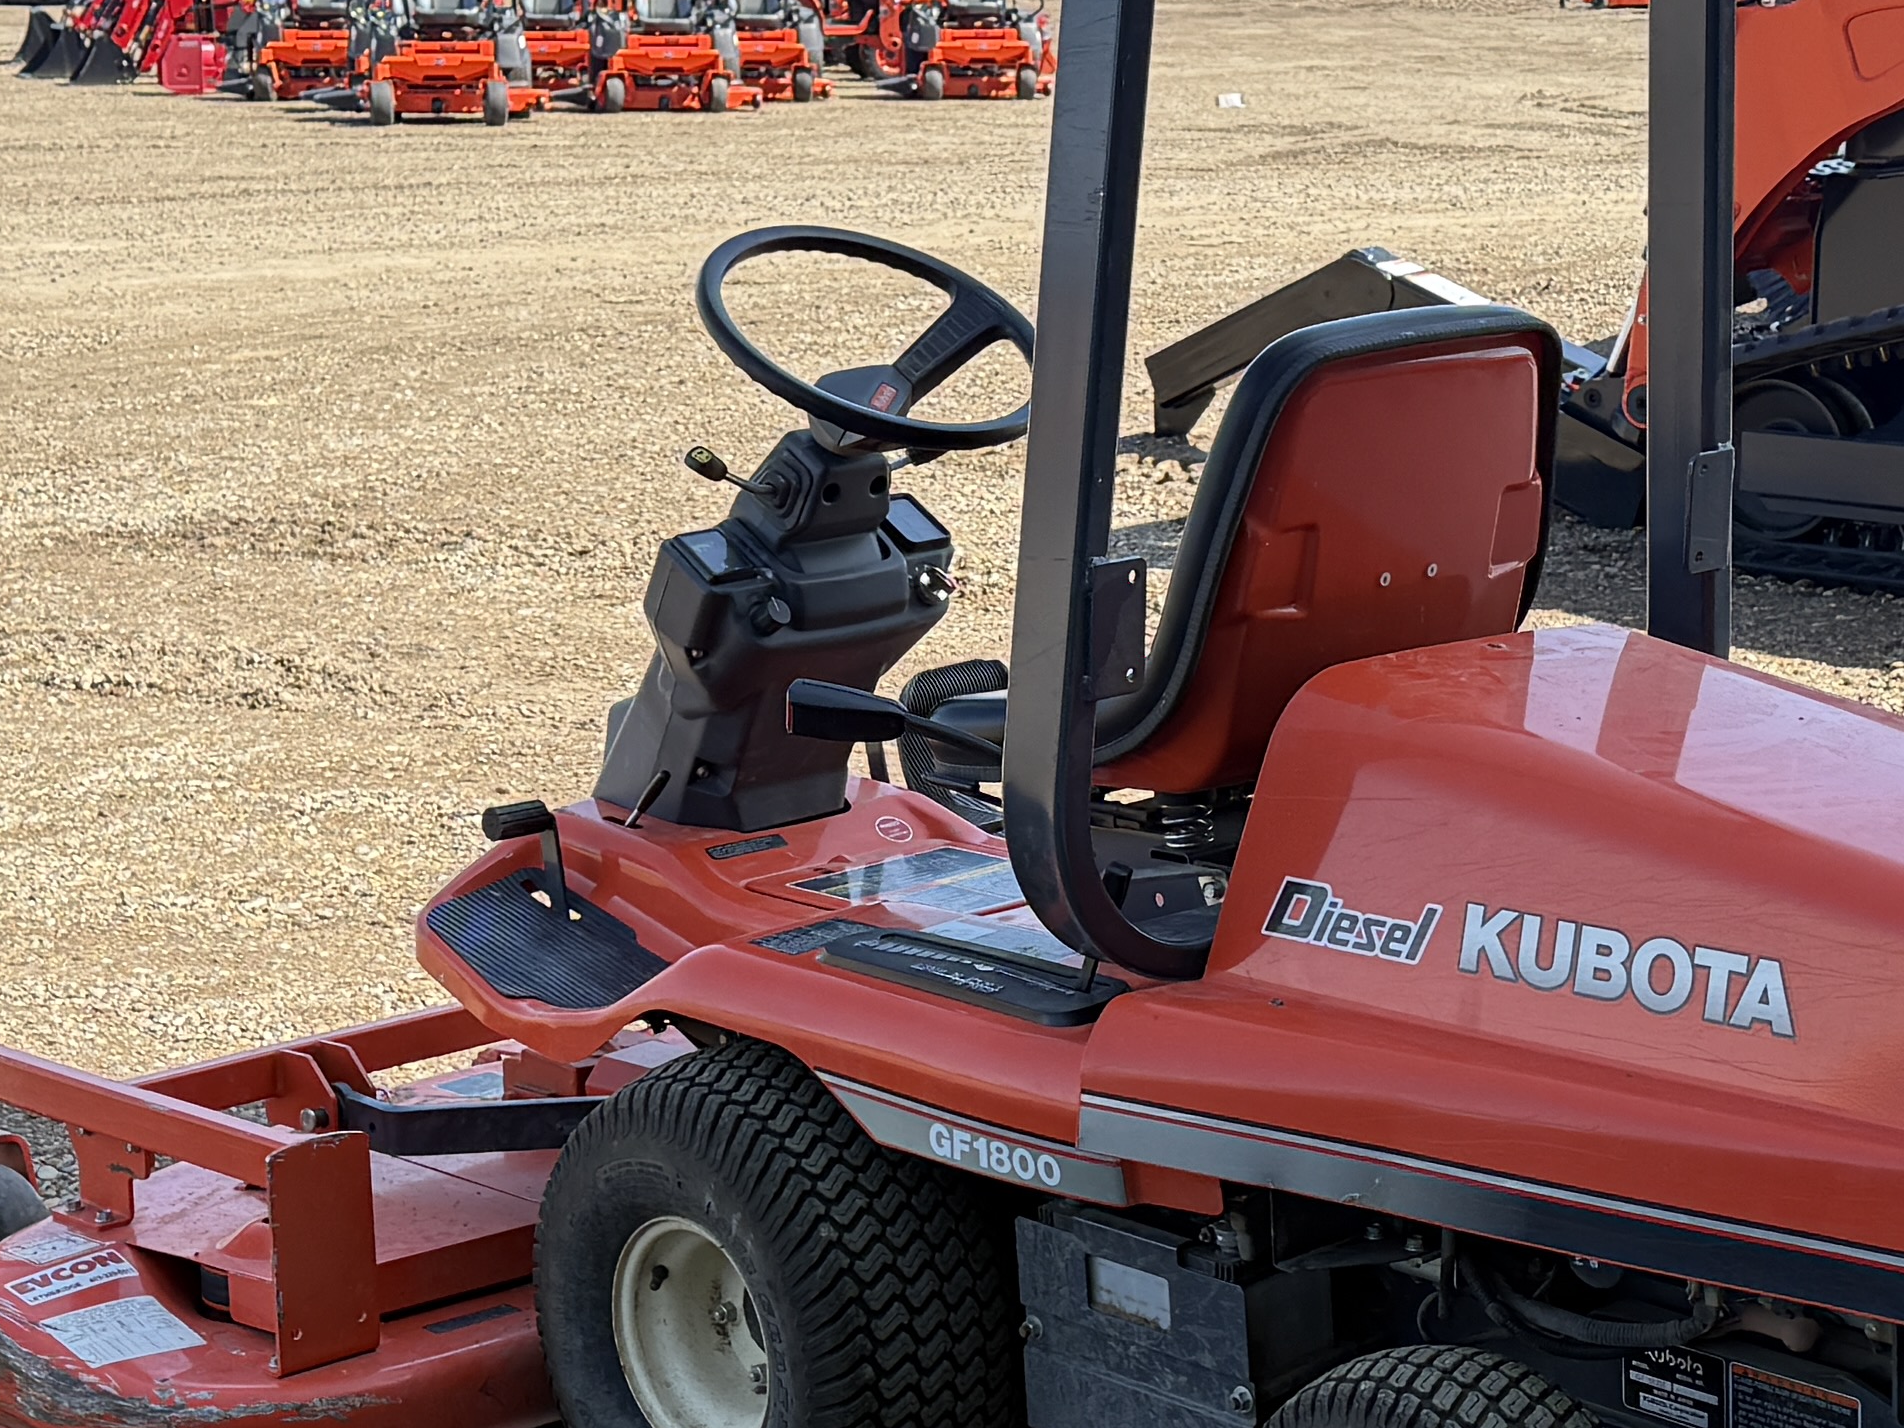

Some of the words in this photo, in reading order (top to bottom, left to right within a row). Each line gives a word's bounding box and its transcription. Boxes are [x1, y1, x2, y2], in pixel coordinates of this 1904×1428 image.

[1261, 876, 1443, 965] Diesel
[1457, 901, 1797, 1040] KUBOTA
[928, 1123, 1061, 1187] GF1800
[10, 1251, 126, 1295] EVCON
